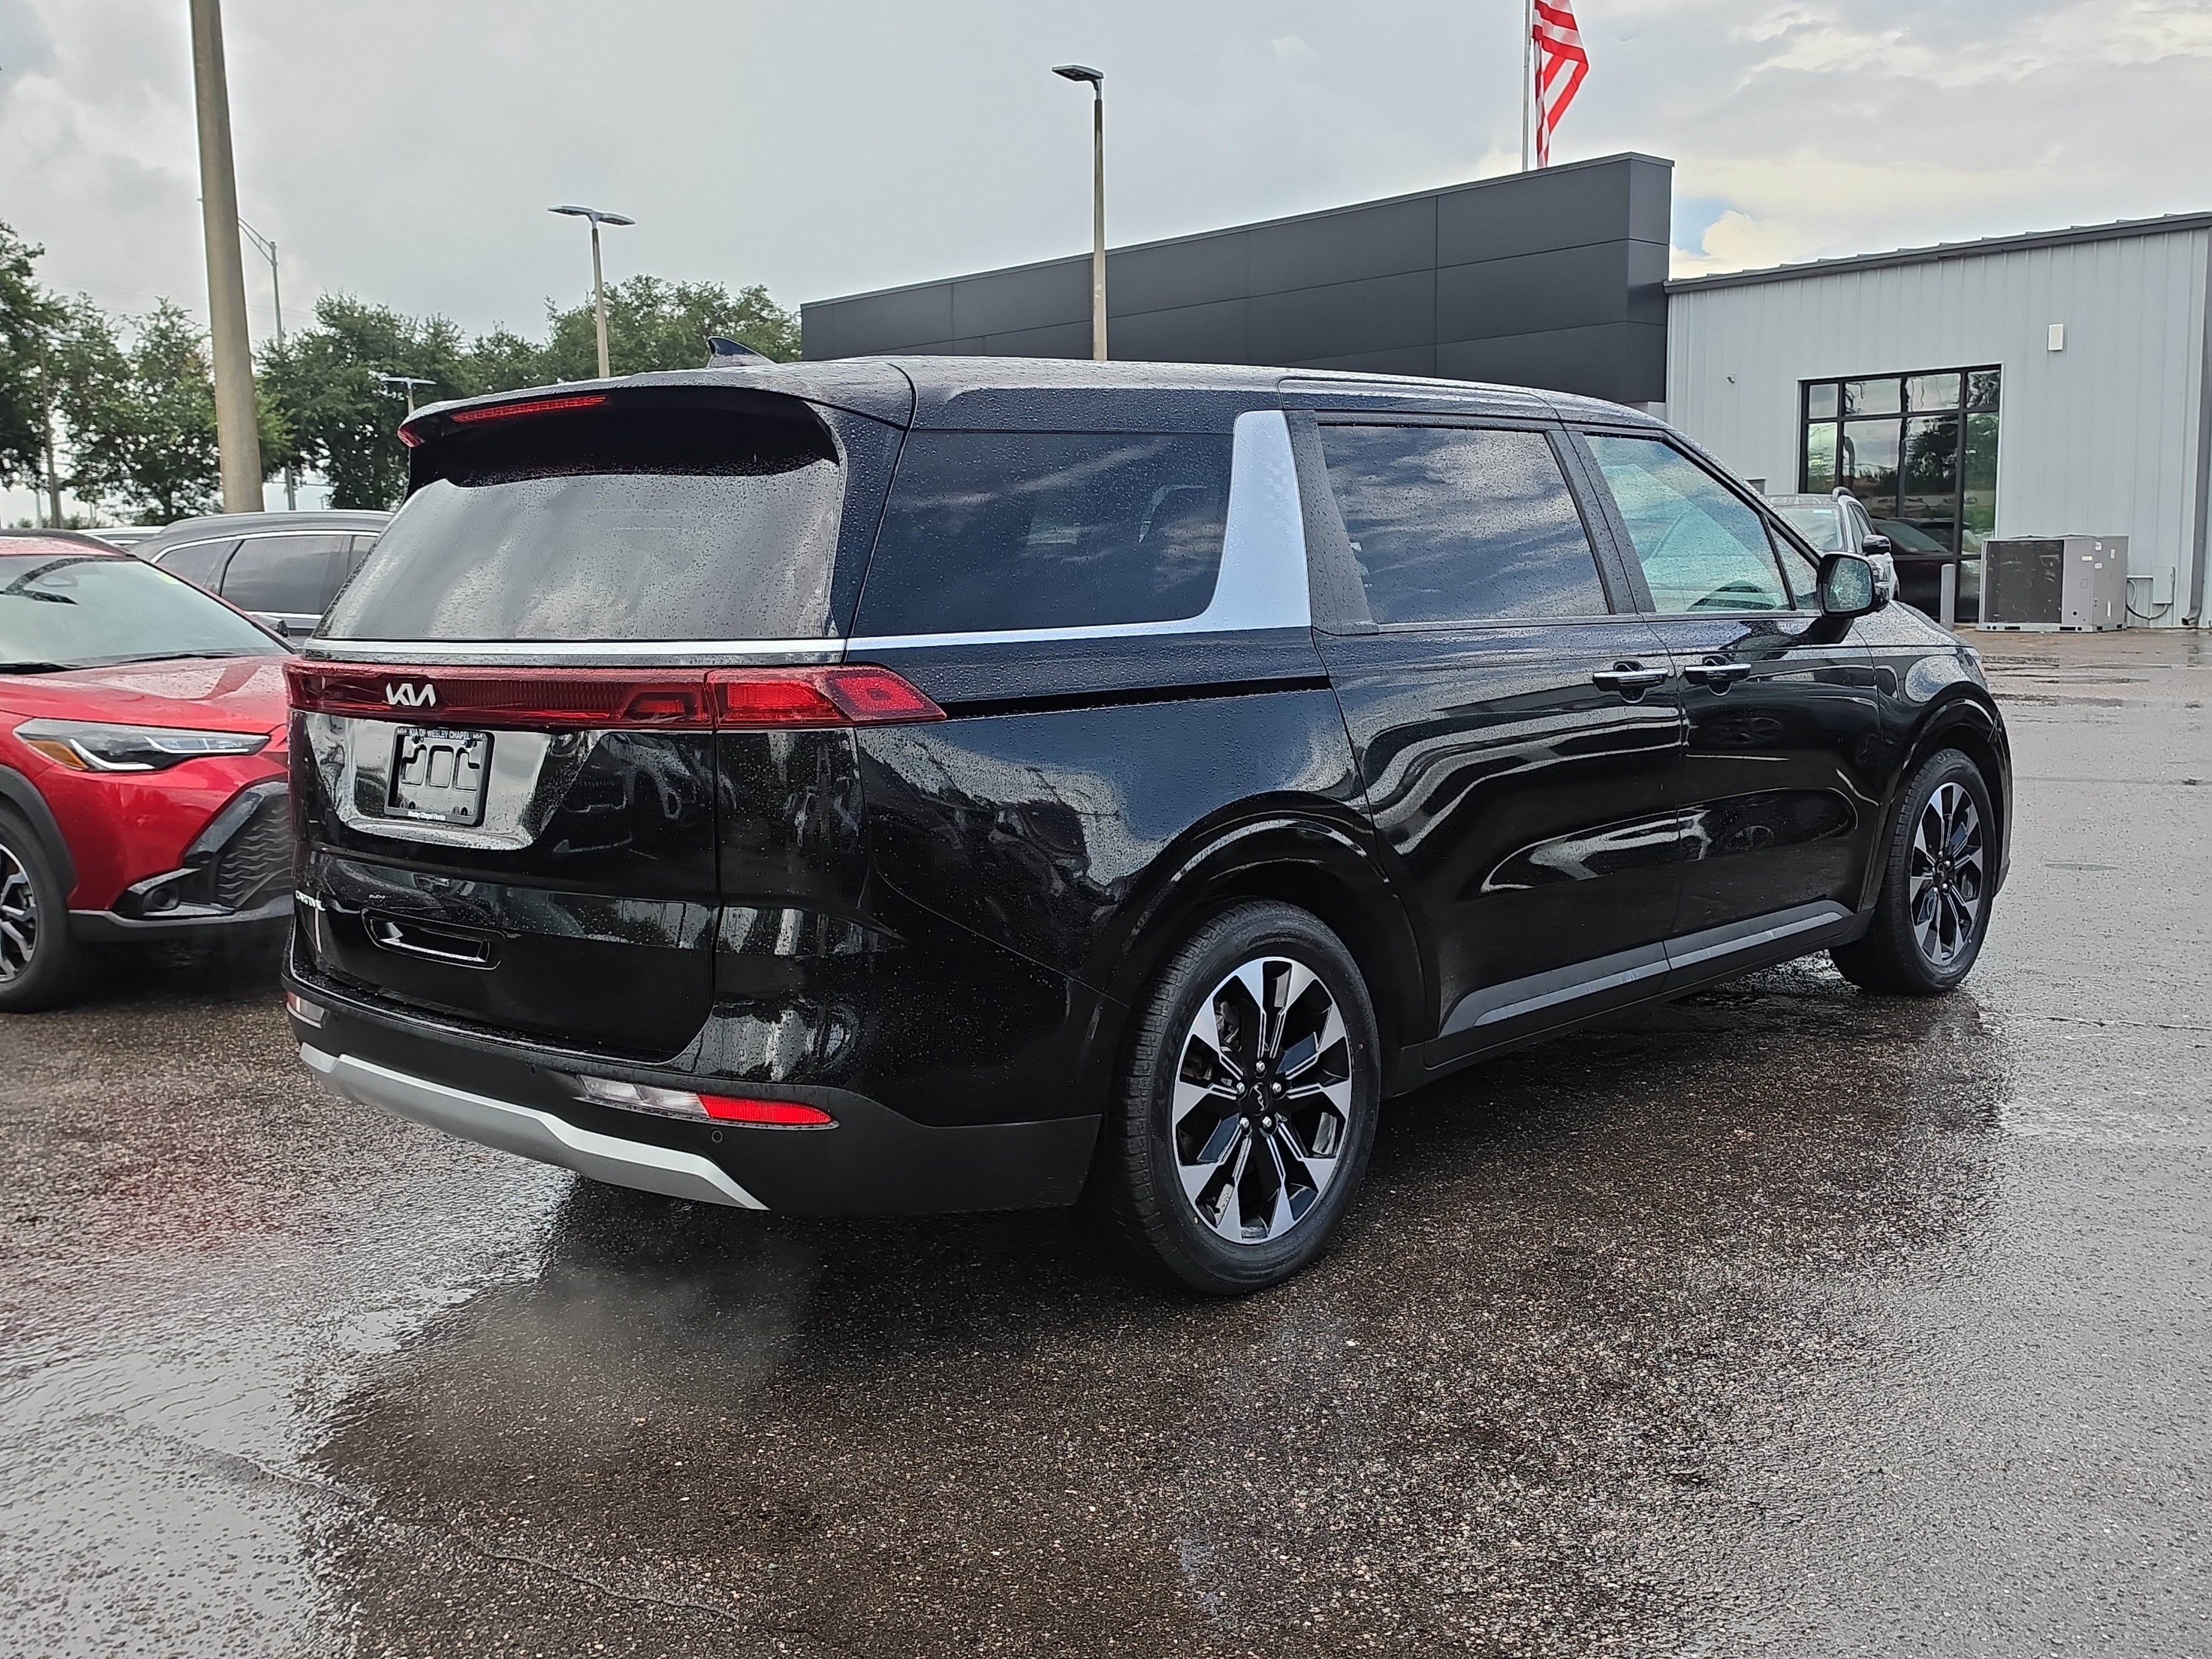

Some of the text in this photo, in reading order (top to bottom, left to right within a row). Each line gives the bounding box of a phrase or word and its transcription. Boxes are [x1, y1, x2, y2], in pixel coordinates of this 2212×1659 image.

[386, 683, 436, 707] KIA
[409, 728, 419, 736] KIA
[427, 730, 448, 738] WESLEY
[449, 730, 471, 740] CHAPEL
